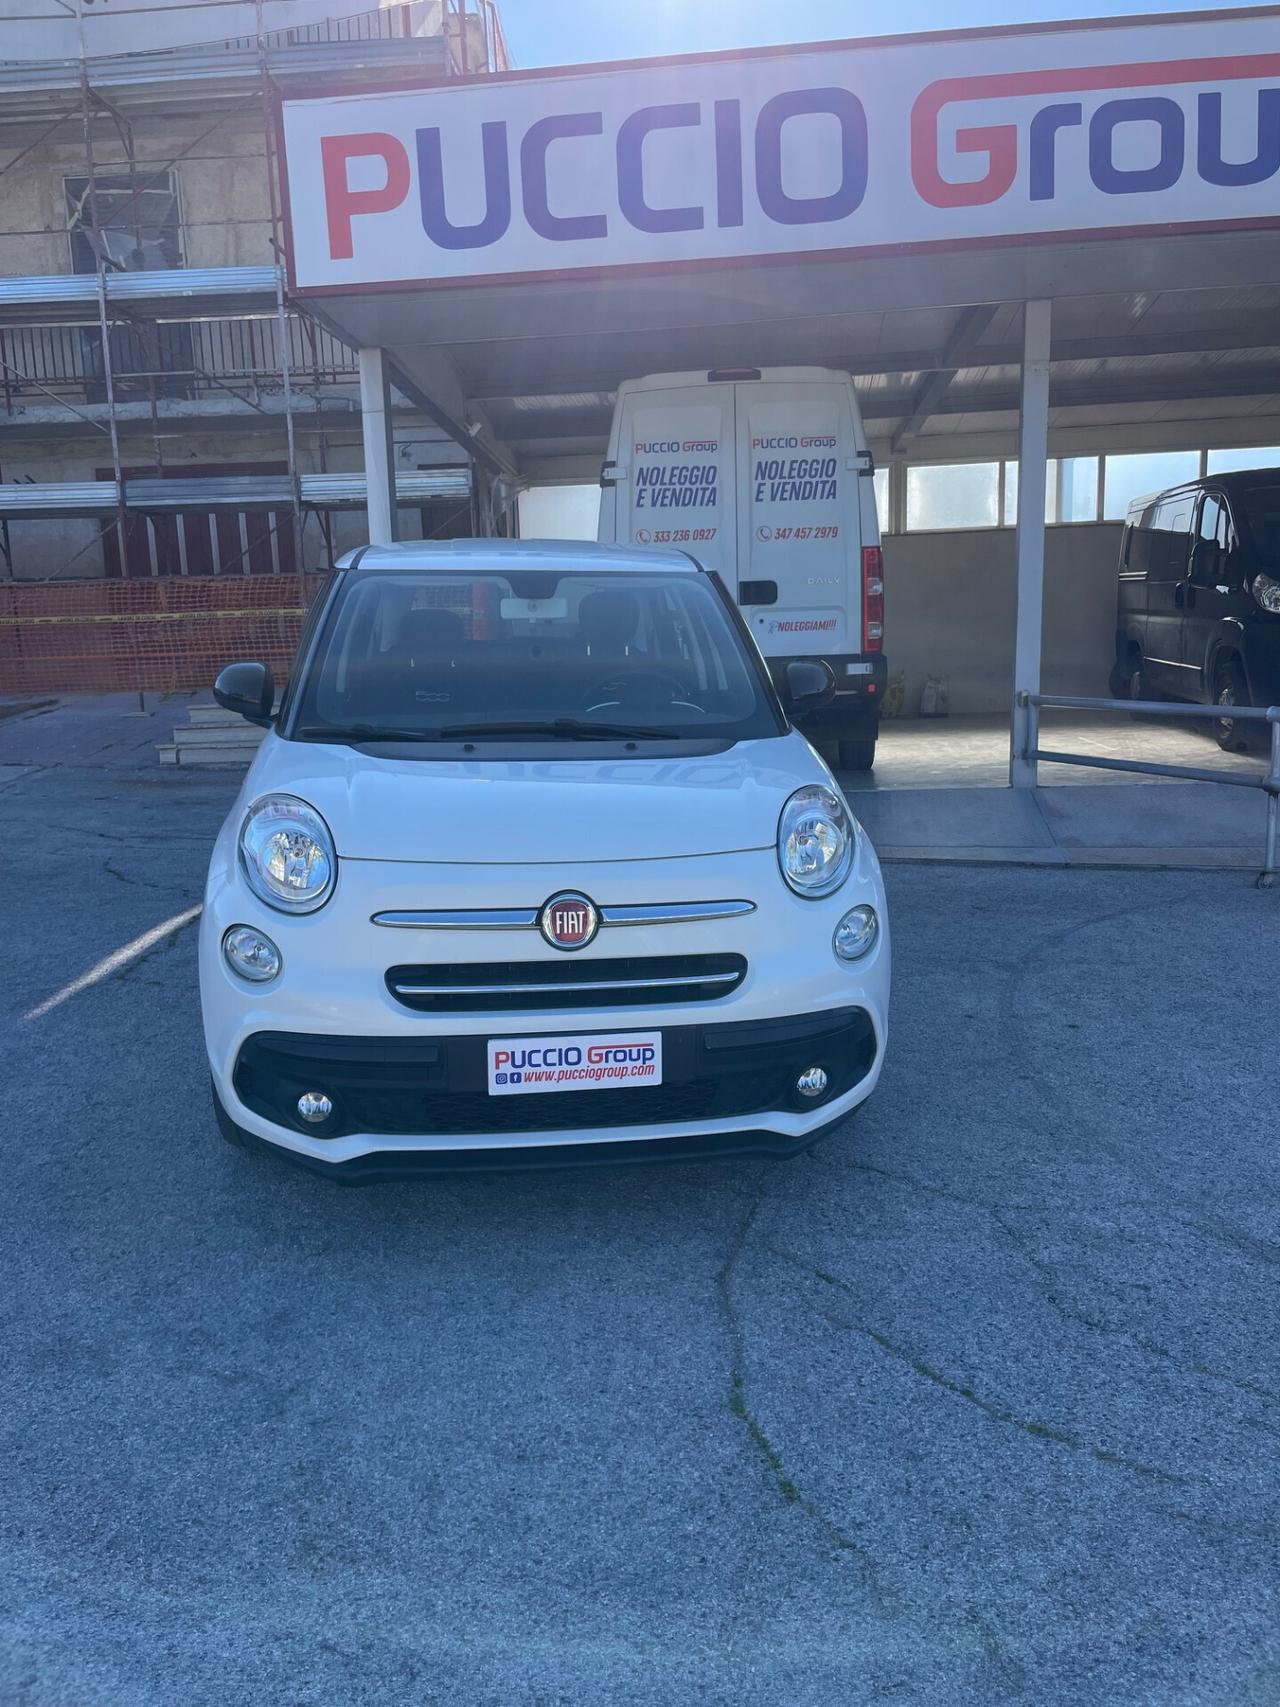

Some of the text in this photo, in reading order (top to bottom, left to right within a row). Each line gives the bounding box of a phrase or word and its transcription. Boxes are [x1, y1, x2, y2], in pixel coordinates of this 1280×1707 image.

[320, 87, 869, 261] PUCCIO
[635, 440, 718, 454] PUCCIO Group
[752, 436, 837, 450] PUCCIO Group
[636, 465, 718, 486] NOLEGGIO
[754, 458, 837, 481] NOLEGGIO
[636, 486, 717, 508] E VENDITA
[755, 480, 837, 502] E VENDITA
[653, 528, 717, 543] 333 236 0927
[774, 526, 839, 540] 347 457 2979
[777, 619, 837, 633] NOLEGGIAMI!!!
[555, 911, 585, 934] FIAT
[495, 1043, 655, 1070] PUCCIO Group
[524, 1064, 655, 1083] www.pucciogroup.com
